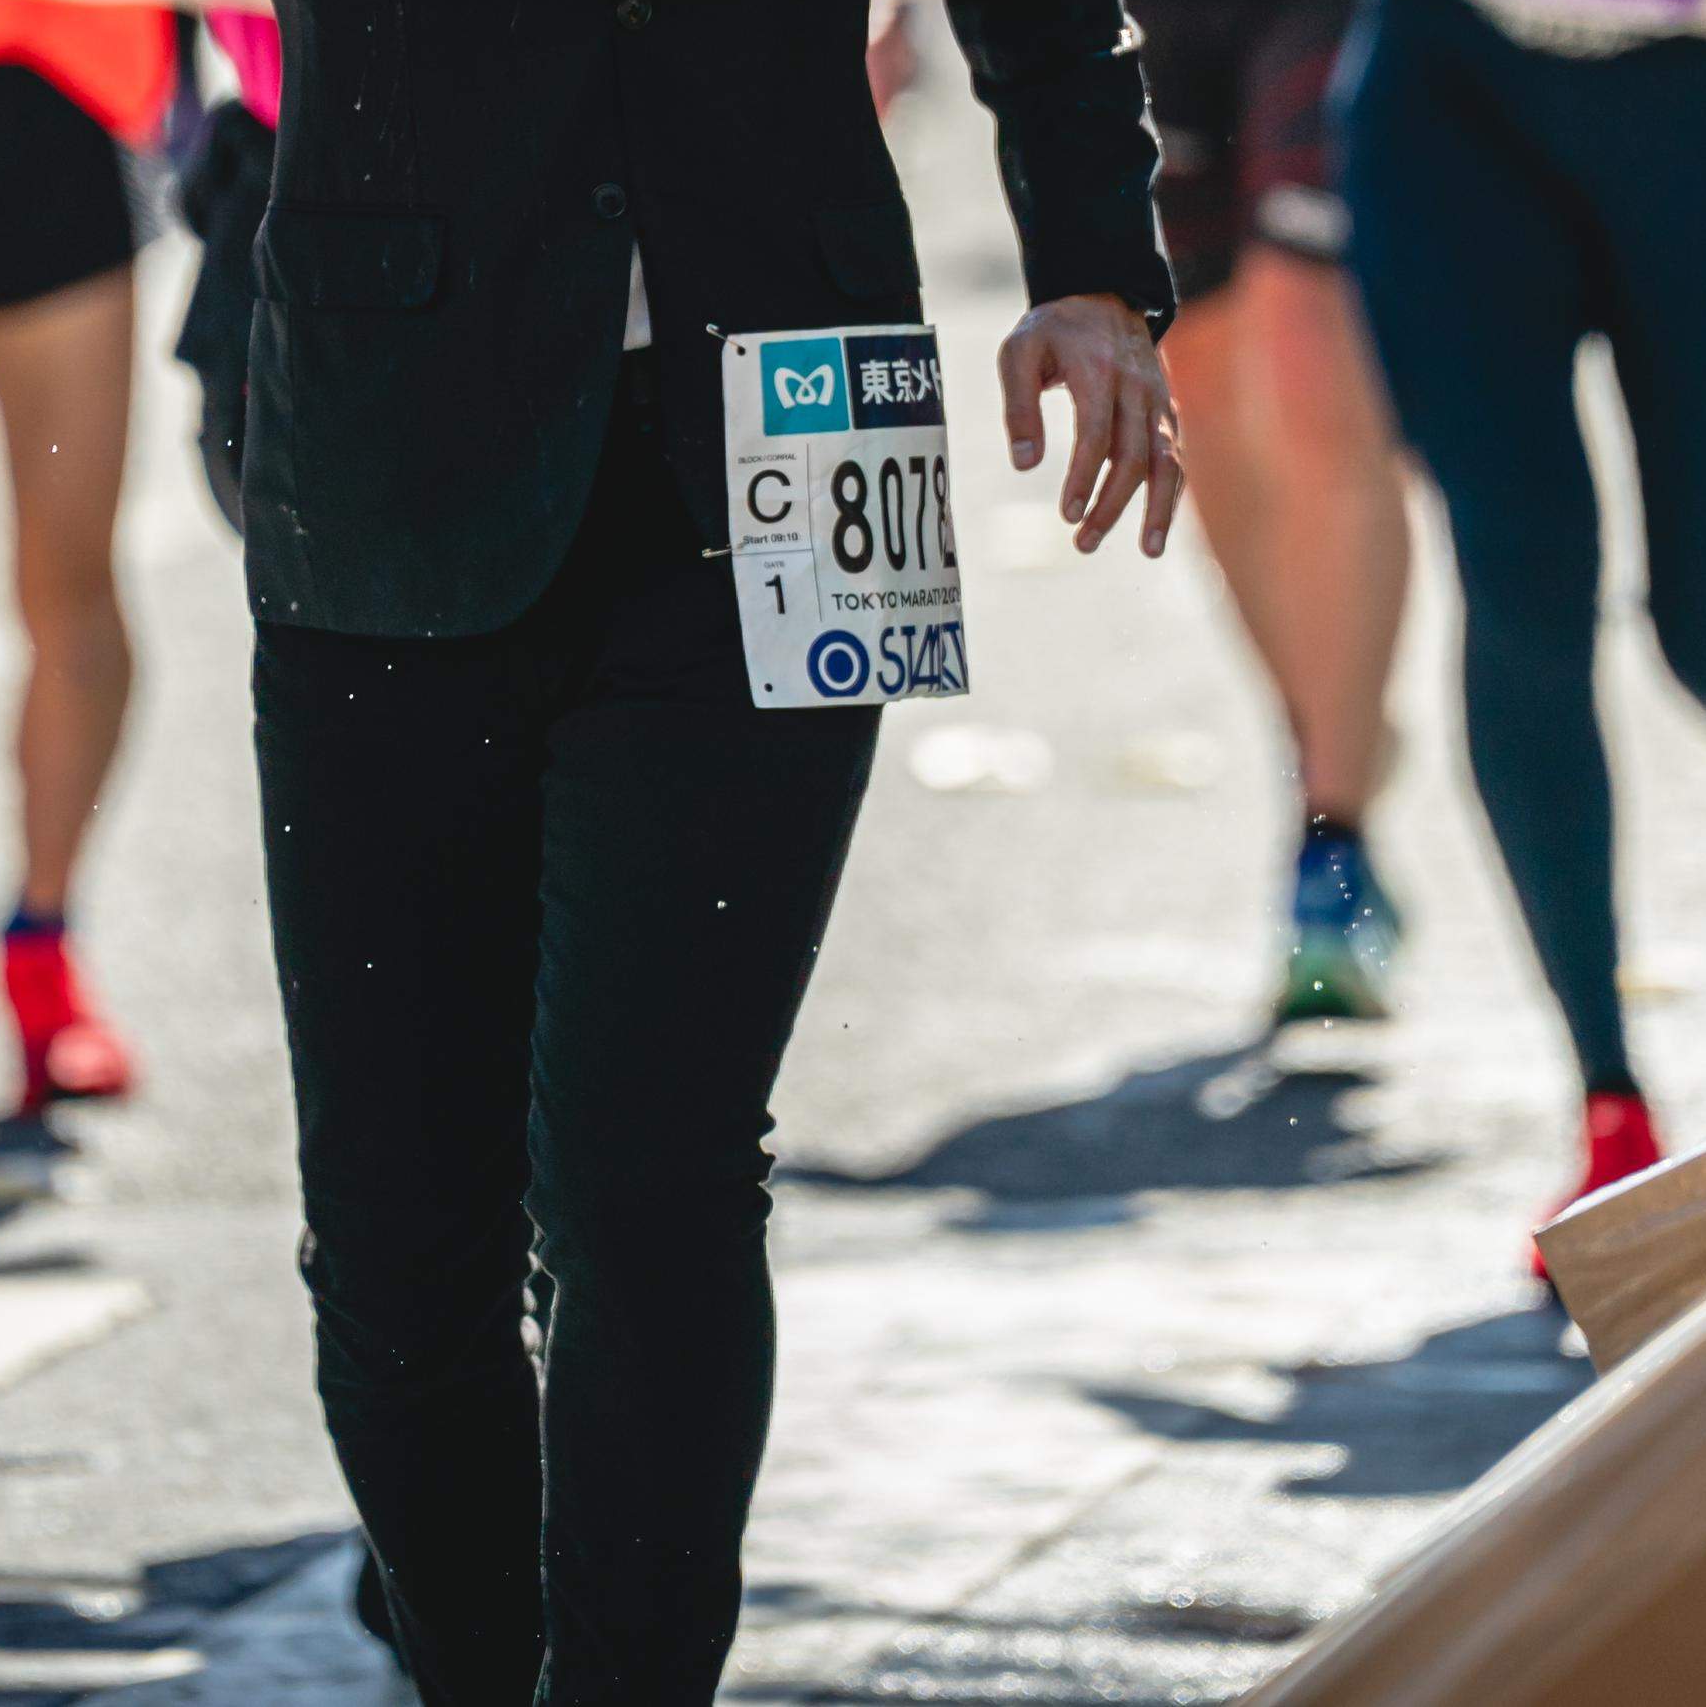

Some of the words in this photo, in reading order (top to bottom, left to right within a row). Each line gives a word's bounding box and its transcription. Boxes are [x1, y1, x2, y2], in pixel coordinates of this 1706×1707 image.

[747, 469, 792, 524] C
[765, 574, 785, 614] 1
[832, 591, 897, 611] TOKYO
